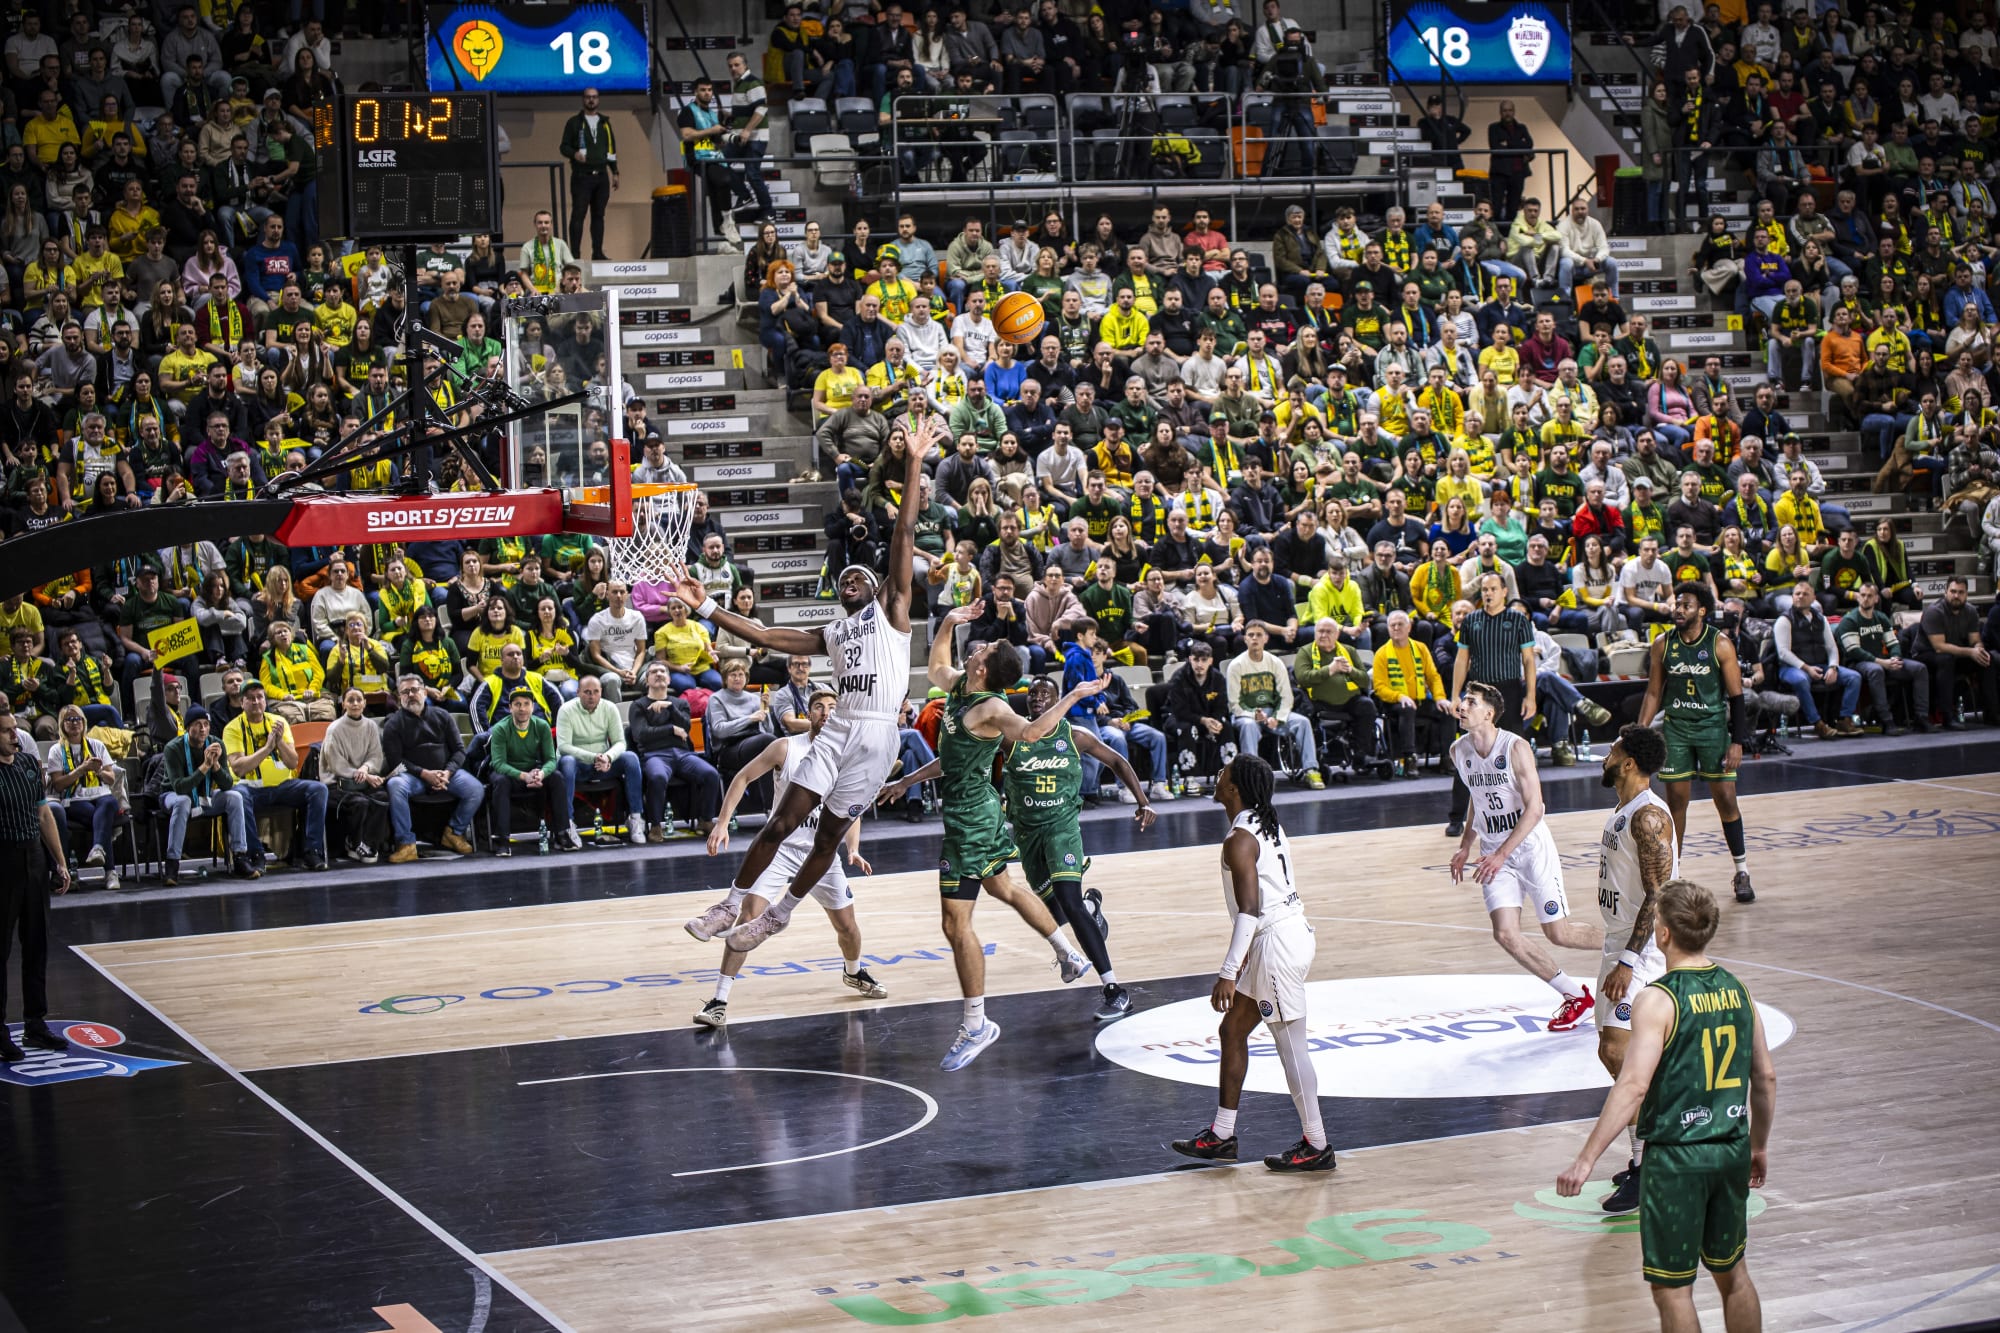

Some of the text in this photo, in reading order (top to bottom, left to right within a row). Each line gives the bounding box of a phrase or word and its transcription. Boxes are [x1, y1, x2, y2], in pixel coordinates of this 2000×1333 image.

[549, 31, 612, 75] 18
[1418, 26, 1471, 67] 18
[358, 150, 397, 163] LGR
[845, 646, 862, 670] 32
[1668, 661, 1711, 675] Levice
[1686, 679, 1696, 696] 5
[1015, 755, 1070, 772] Levice
[1034, 775, 1057, 793] 55
[1034, 797, 1064, 807] VEOLIA
[1485, 791, 1504, 811] 35
[1141, 1022, 1314, 1052] oybu
[1701, 1024, 1742, 1092] 12
[829, 1208, 1493, 1326] green
[1411, 1250, 1521, 1271] THE
[812, 1249, 1116, 1296] ALLIANCE
